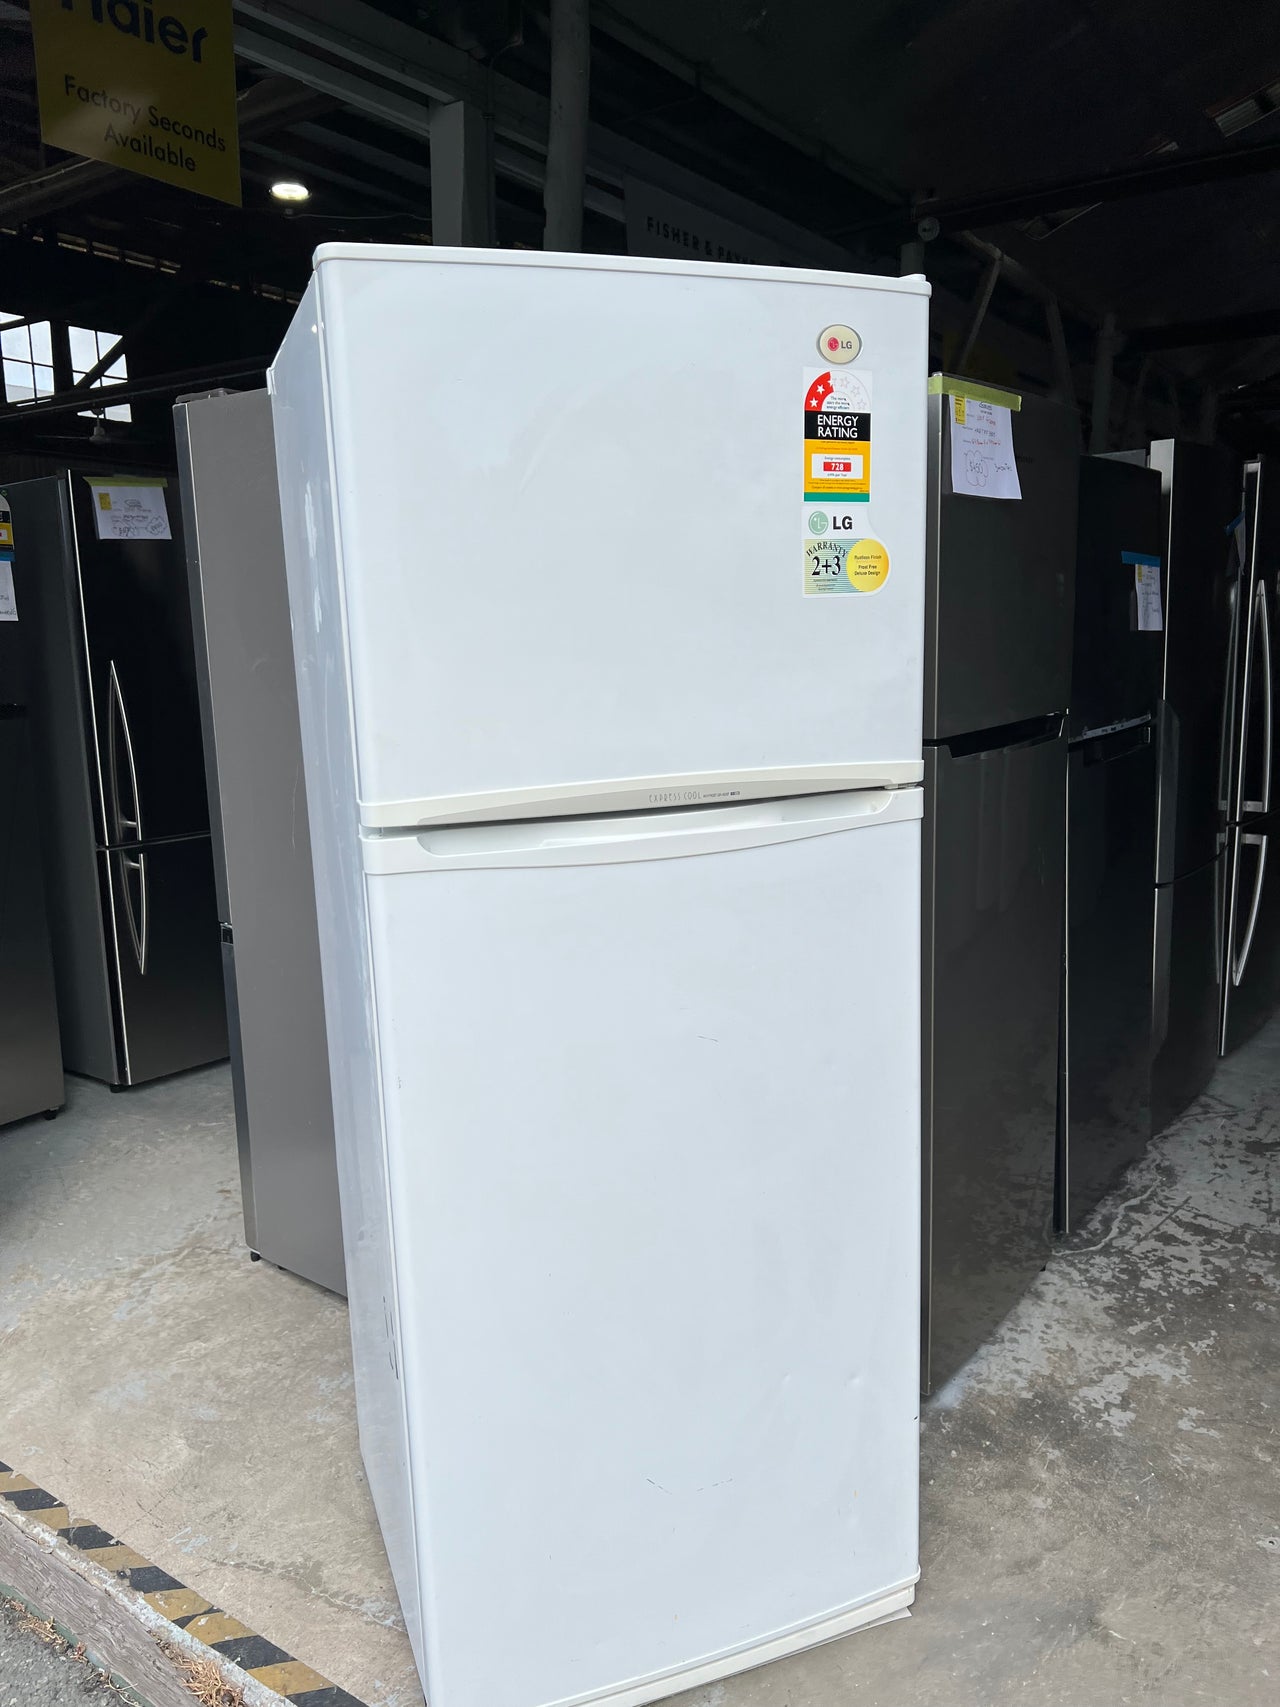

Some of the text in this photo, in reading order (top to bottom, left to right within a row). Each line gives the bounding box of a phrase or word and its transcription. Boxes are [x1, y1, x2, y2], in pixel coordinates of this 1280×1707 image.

[64, 74, 226, 152] Factory Seconds
[104, 123, 197, 172] Available
[647, 215, 756, 264] FISHER & PAY
[841, 341, 853, 350] LG
[817, 414, 859, 427] ENERGY
[817, 426, 858, 439] RATING
[831, 463, 844, 471] 728
[833, 515, 853, 530] LG
[806, 541, 848, 558] WARRANTY
[811, 555, 841, 576] 2+3
[683, 791, 702, 801] COOL
